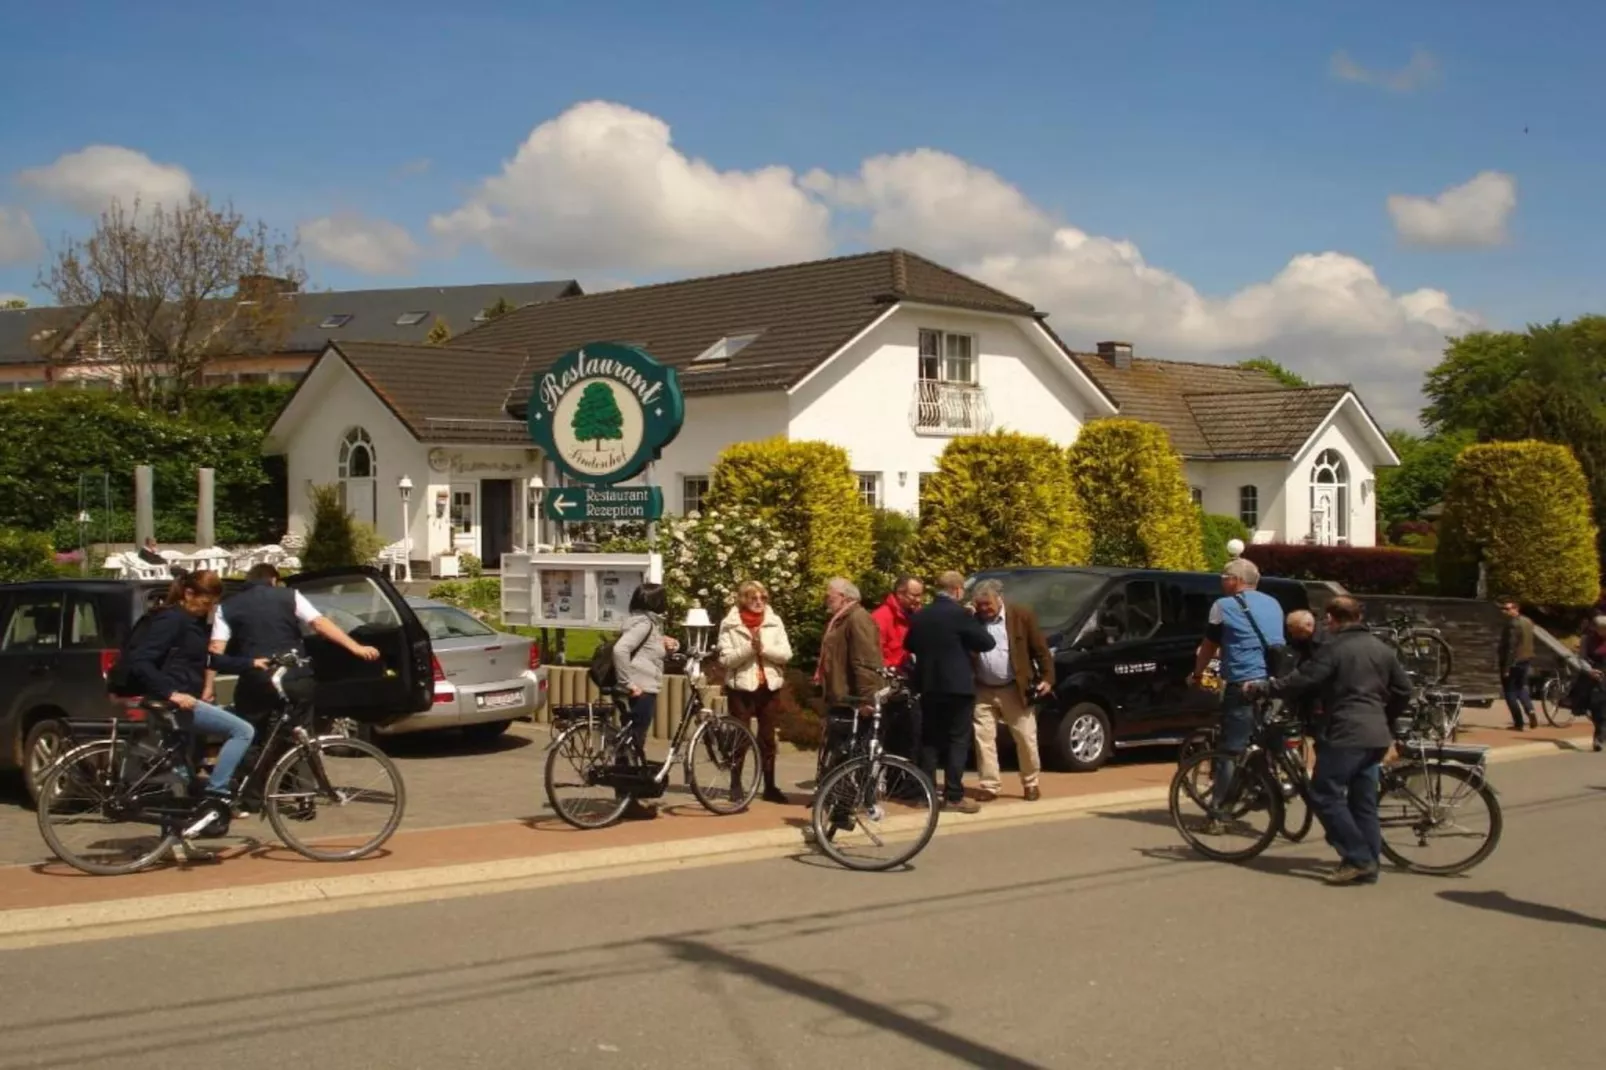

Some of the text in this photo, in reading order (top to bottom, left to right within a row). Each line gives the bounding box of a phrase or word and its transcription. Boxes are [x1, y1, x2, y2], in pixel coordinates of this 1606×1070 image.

[540, 349, 663, 412] Restaurant
[586, 488, 648, 501] Restaurant
[586, 503, 645, 518] Rezeption
